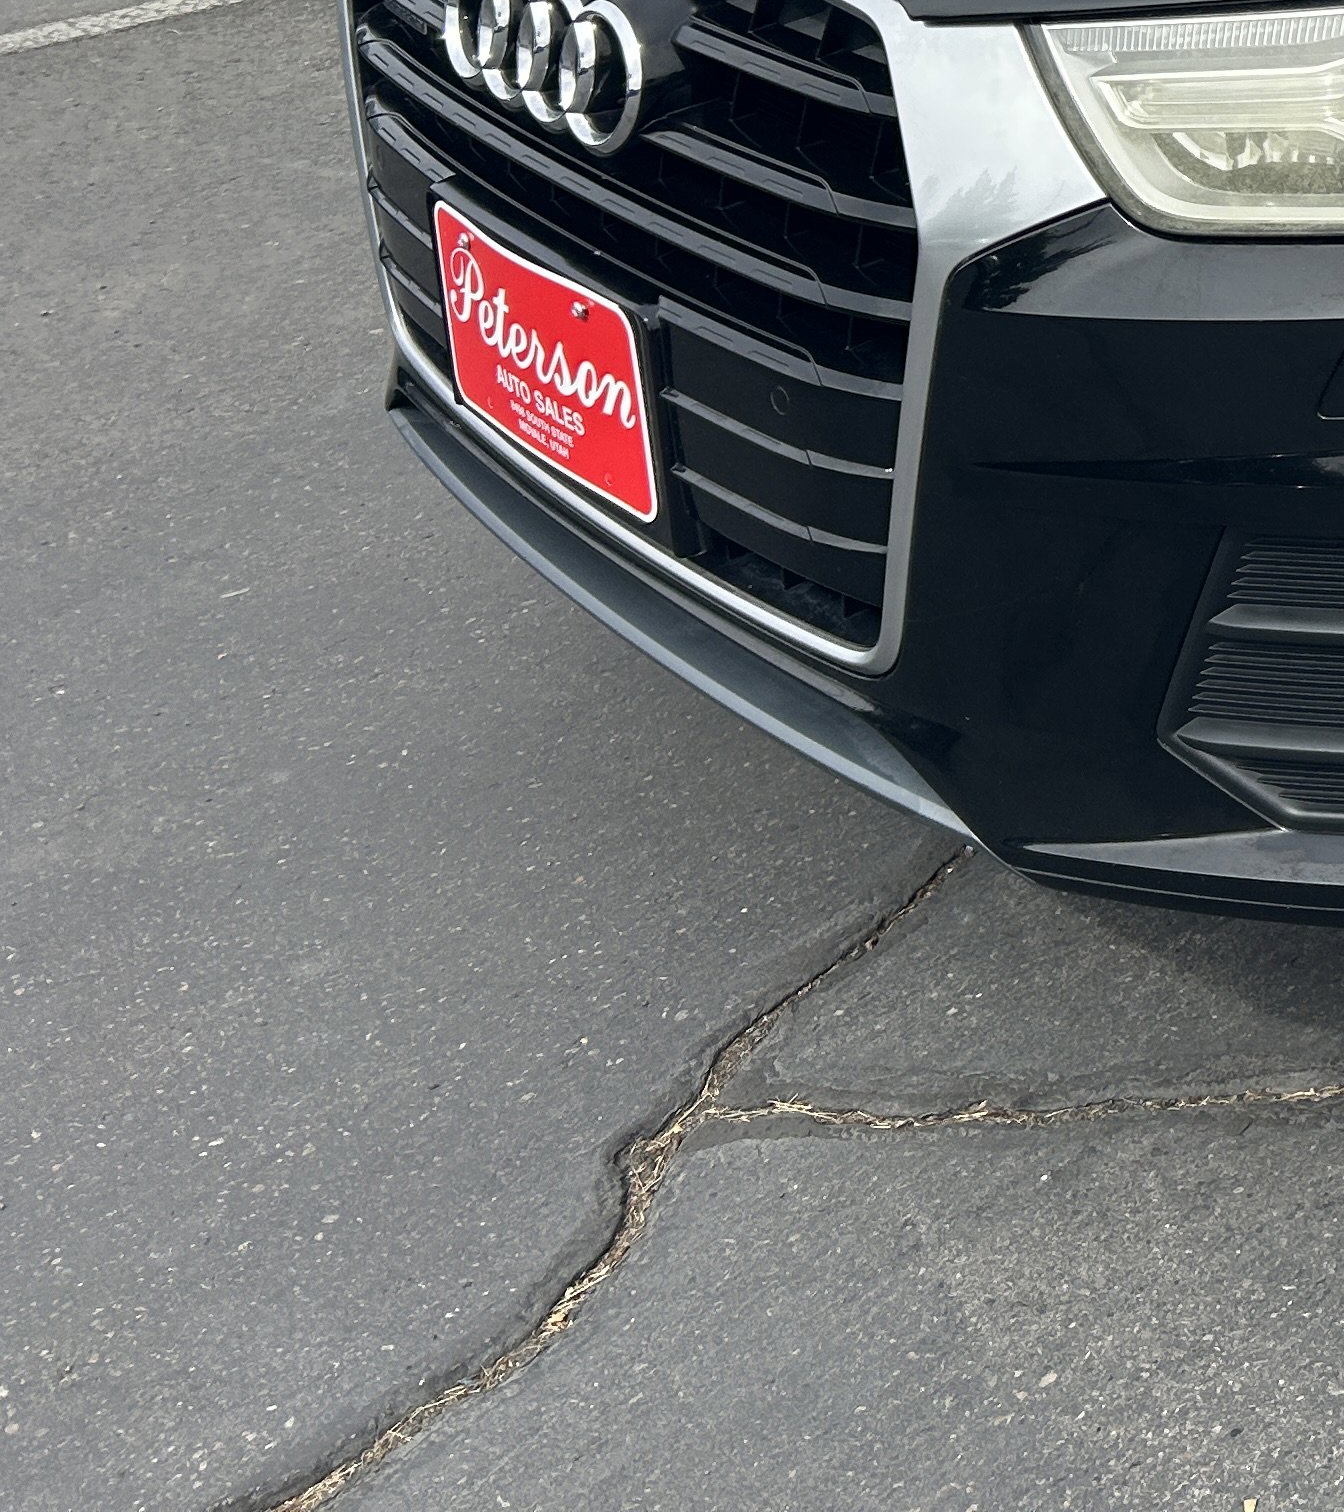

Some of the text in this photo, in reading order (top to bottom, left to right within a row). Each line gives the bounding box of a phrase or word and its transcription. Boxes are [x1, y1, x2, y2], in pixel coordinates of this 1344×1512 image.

[449, 246, 637, 430] Peterson
[496, 364, 531, 405] AUTO
[534, 390, 586, 436] SALES
